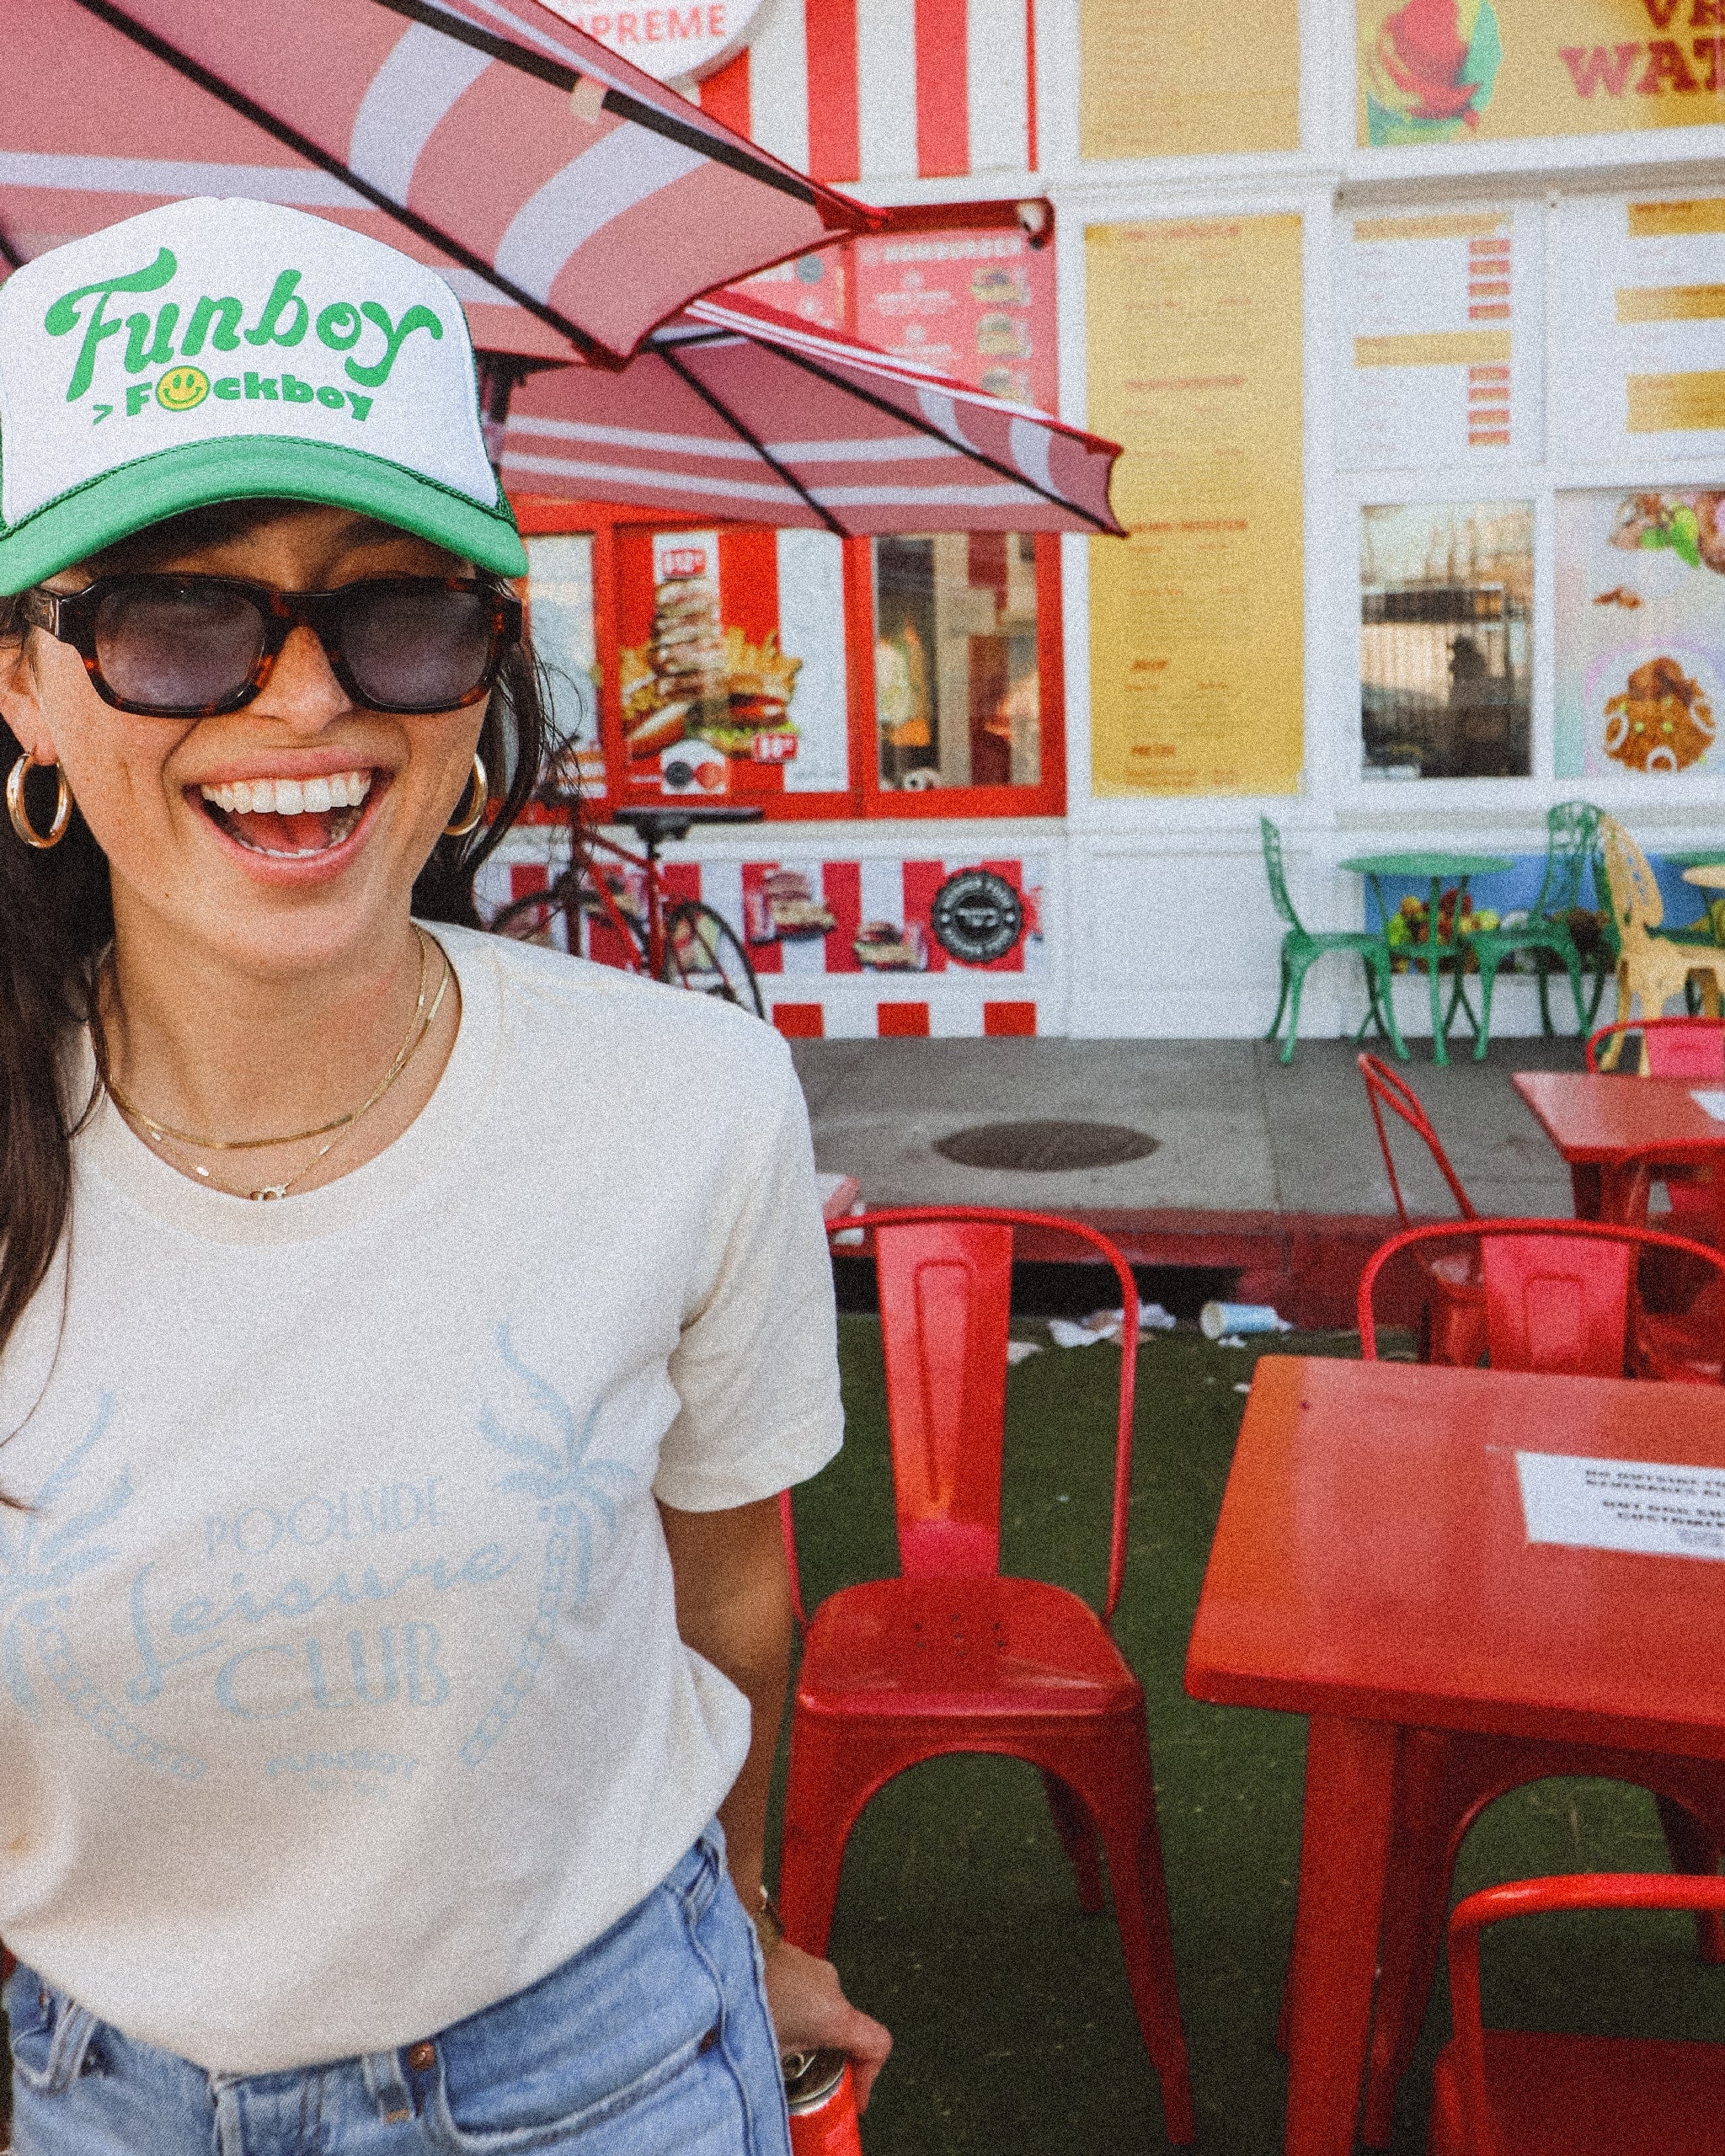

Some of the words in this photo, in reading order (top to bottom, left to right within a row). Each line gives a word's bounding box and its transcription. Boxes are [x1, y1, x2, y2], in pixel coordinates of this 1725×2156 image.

[574, 4, 726, 44] PREME
[45, 247, 443, 403] Funboy
[205, 1475, 446, 1561] POOLSIDE
[125, 1541, 521, 1705] Leisure
[213, 1620, 452, 1721] CLUB
